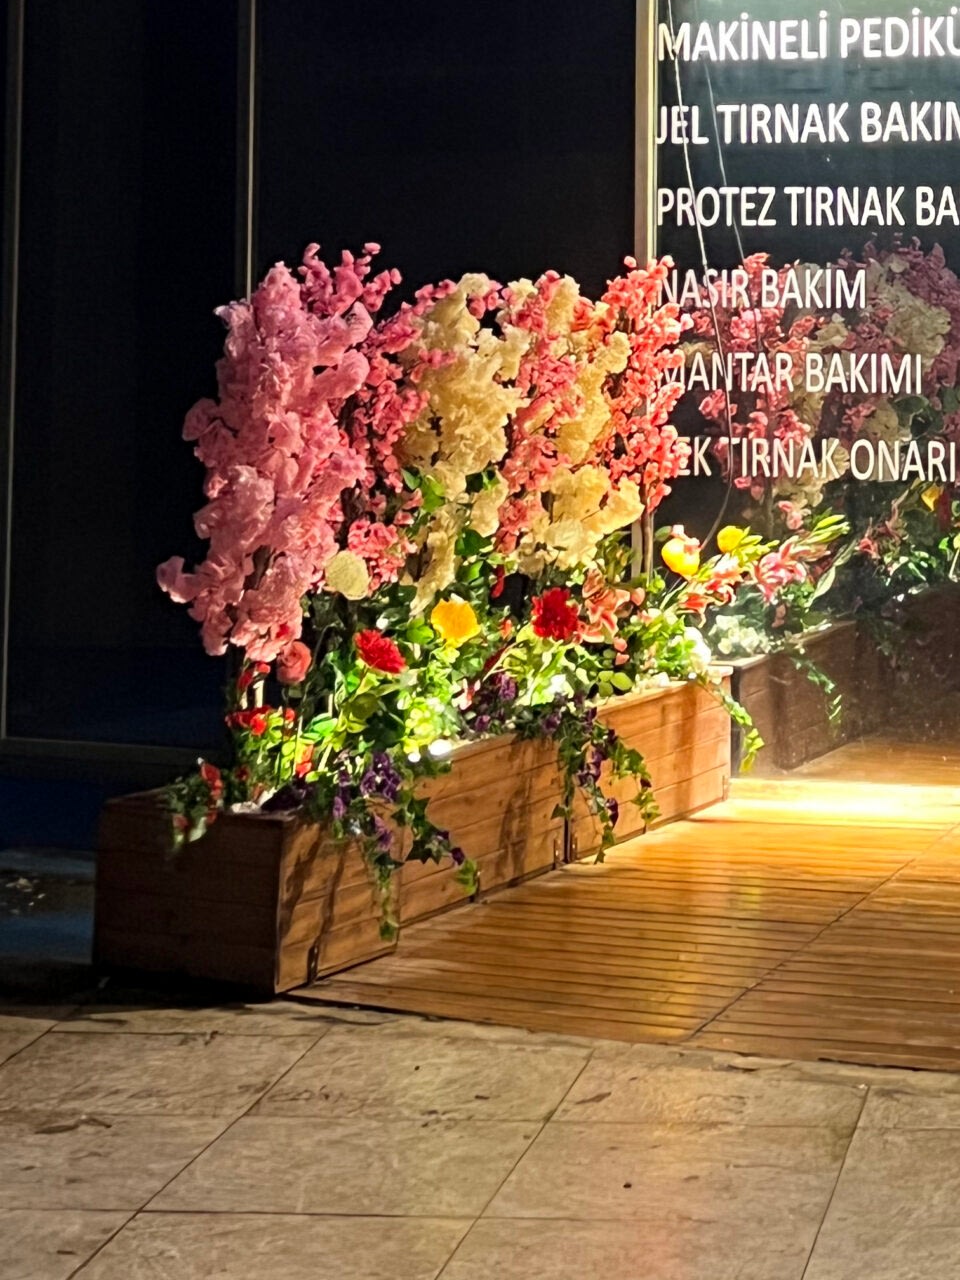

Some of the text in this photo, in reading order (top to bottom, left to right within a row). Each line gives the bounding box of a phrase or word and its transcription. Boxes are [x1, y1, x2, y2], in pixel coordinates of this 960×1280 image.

[658, 10, 828, 62] MAKİNELİ
[655, 105, 710, 145] JEL
[716, 102, 850, 145] TIRNAK
[657, 186, 777, 227] PROTEZ
[783, 186, 906, 226] TIRNAK
[657, 268, 867, 309] NASIR BAKIM
[806, 352, 922, 395] BAKIMI
